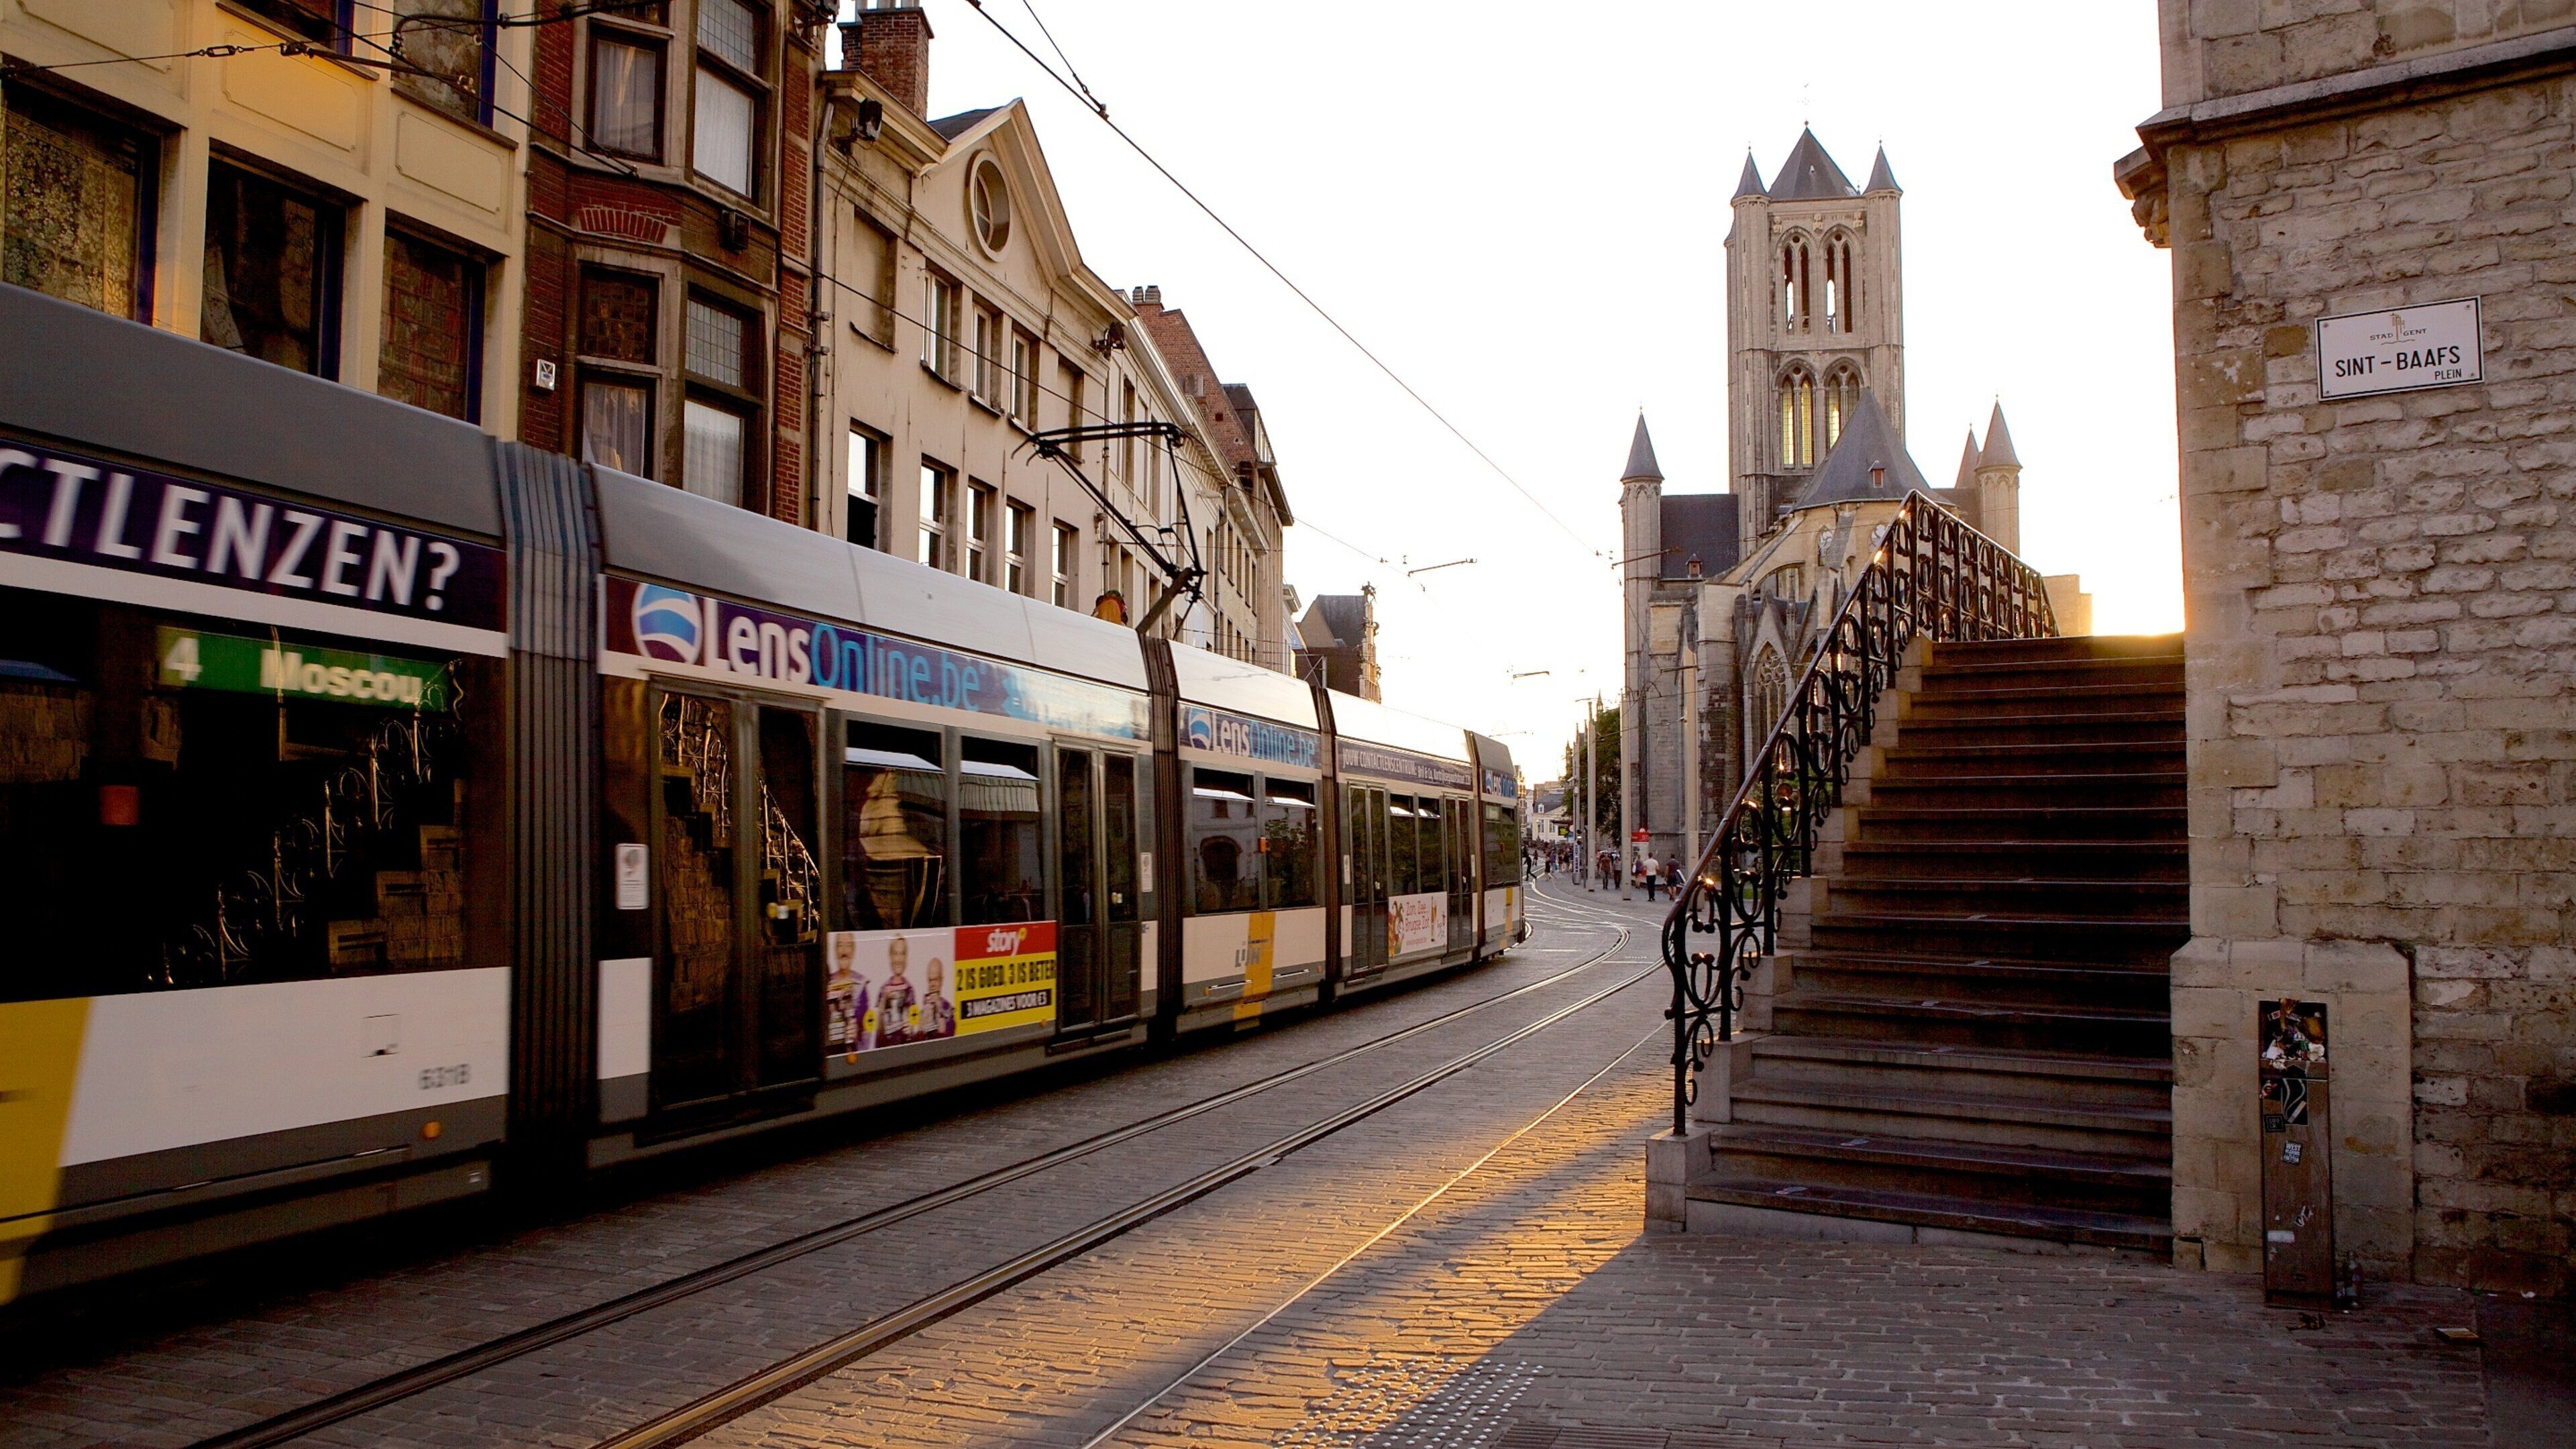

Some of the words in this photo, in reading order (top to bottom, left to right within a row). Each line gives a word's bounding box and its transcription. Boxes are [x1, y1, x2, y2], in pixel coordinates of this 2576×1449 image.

[2369, 333, 2394, 341] STAD
[2403, 328, 2427, 336] GENT
[2434, 368, 2462, 381] PLEIN
[704, 596, 980, 711] LensOnline.be
[165, 637, 203, 682] 4
[260, 647, 423, 704] Moscou
[1212, 712, 1316, 768] LensOnline.be
[986, 928, 1020, 957] story
[957, 969, 963, 991] 2
[1009, 963, 1015, 985] 3
